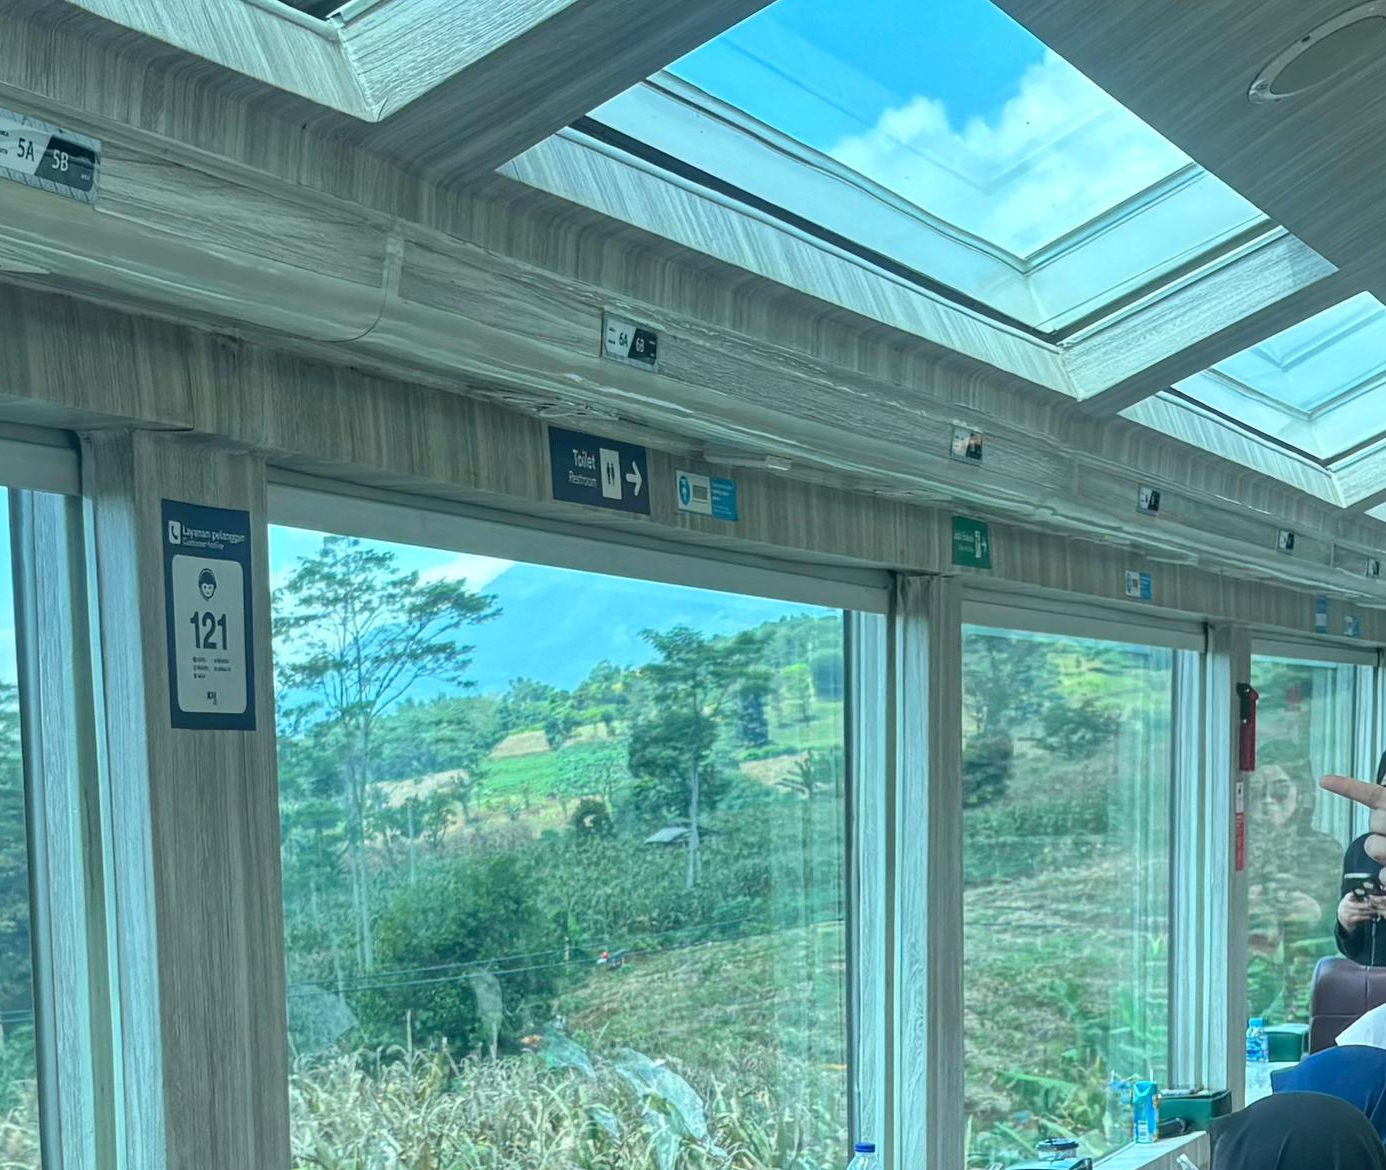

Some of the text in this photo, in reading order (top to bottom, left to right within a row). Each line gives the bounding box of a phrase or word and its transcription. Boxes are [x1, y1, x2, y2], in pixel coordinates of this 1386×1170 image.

[17, 137, 35, 162] 5A
[51, 149, 69, 172] 5B
[572, 448, 596, 470] Toilet
[190, 611, 227, 650] 121
